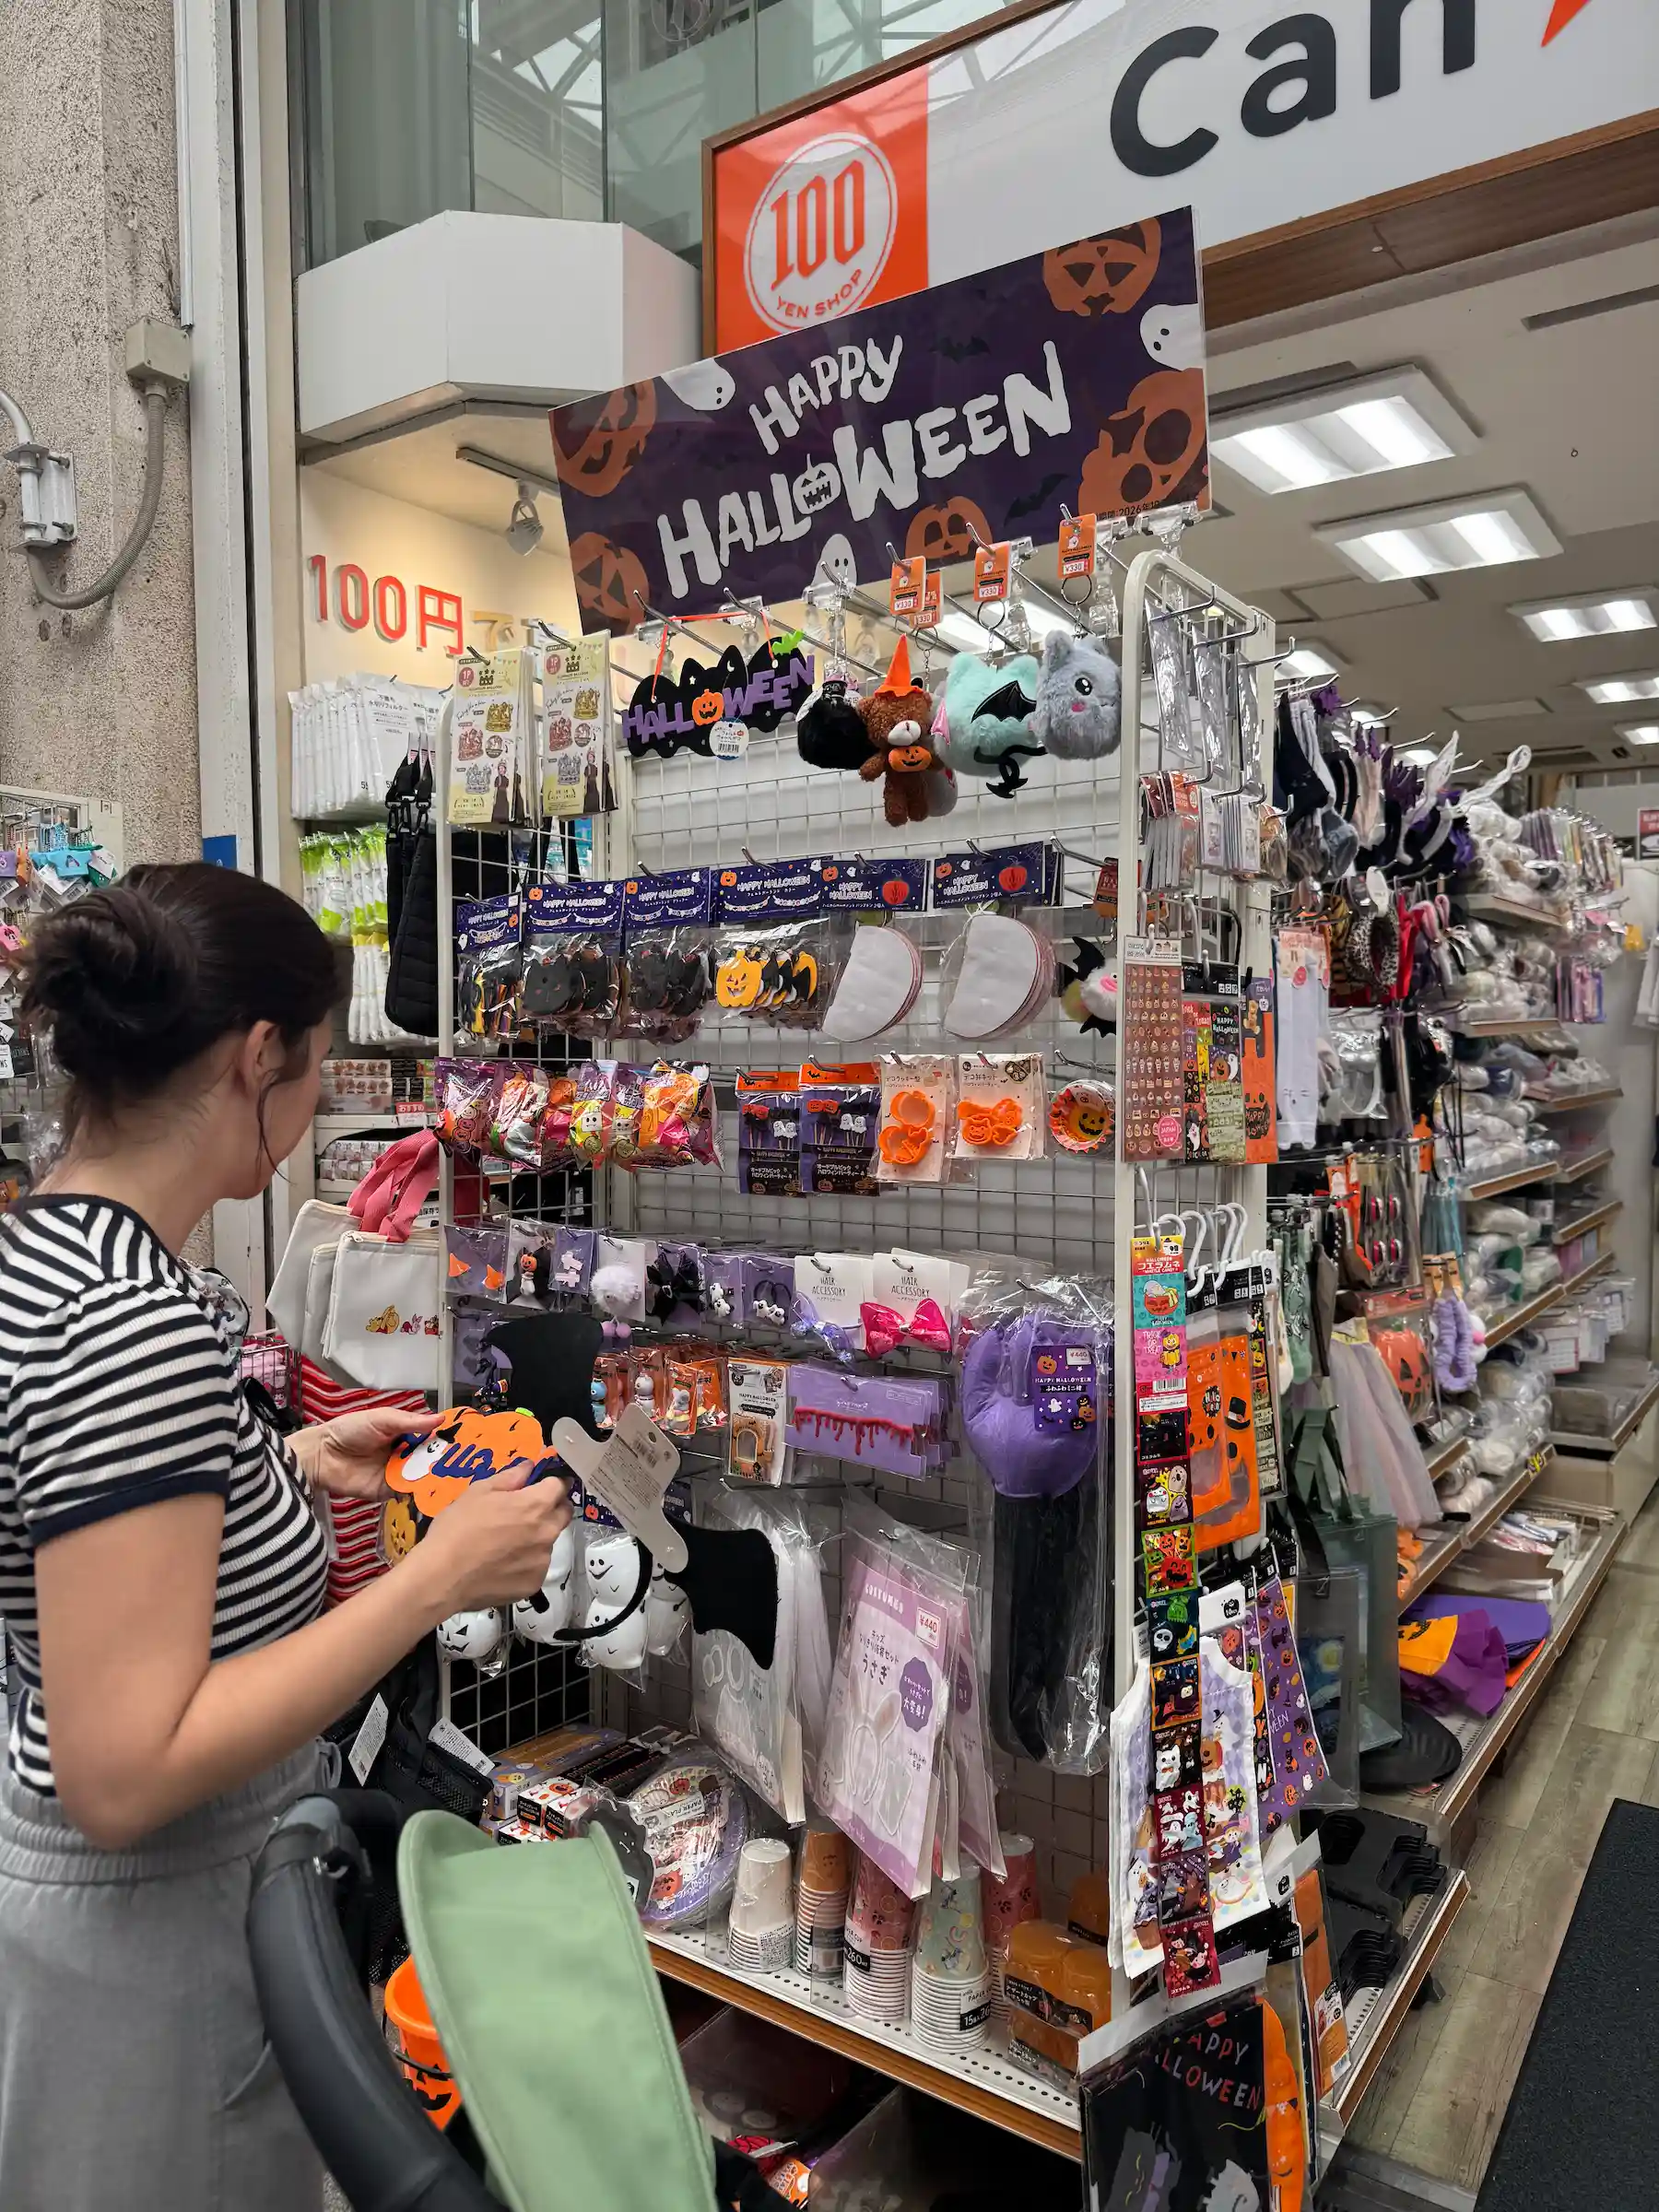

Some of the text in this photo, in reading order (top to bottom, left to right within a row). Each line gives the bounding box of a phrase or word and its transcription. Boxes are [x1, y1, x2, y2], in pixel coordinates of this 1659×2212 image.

[771, 159, 865, 291] 100
[777, 269, 863, 319] YEN SHOP
[748, 335, 903, 455] HAPPY
[737, 875, 810, 892] HAPPY HALLOWEEN
[838, 881, 864, 891] HAPPY
[952, 874, 979, 886] HAPPY
[639, 887, 695, 901] HAPPY HALLOWEEN
[830, 890, 873, 900] HALLOWEEN
[943, 881, 989, 896] HALLOWEEN
[543, 898, 606, 908] HAPPY HALLOWEEN
[1217, 1017, 1234, 1025] HAPPY
[820, 1276, 836, 1286] HAIR
[901, 1276, 918, 1286] HAIR
[812, 1285, 846, 1297] ACCESSORY
[891, 1285, 930, 1298] ACCESSORY
[920, 1615, 938, 1633] ¥440
[871, 1630, 886, 1644] キッズ
[862, 1653, 890, 1686] うさぎ
[968, 1990, 985, 2002] PAPER
[1173, 2031, 1249, 2065] APPY
[1155, 2047, 1262, 2112] LLOWEEN
